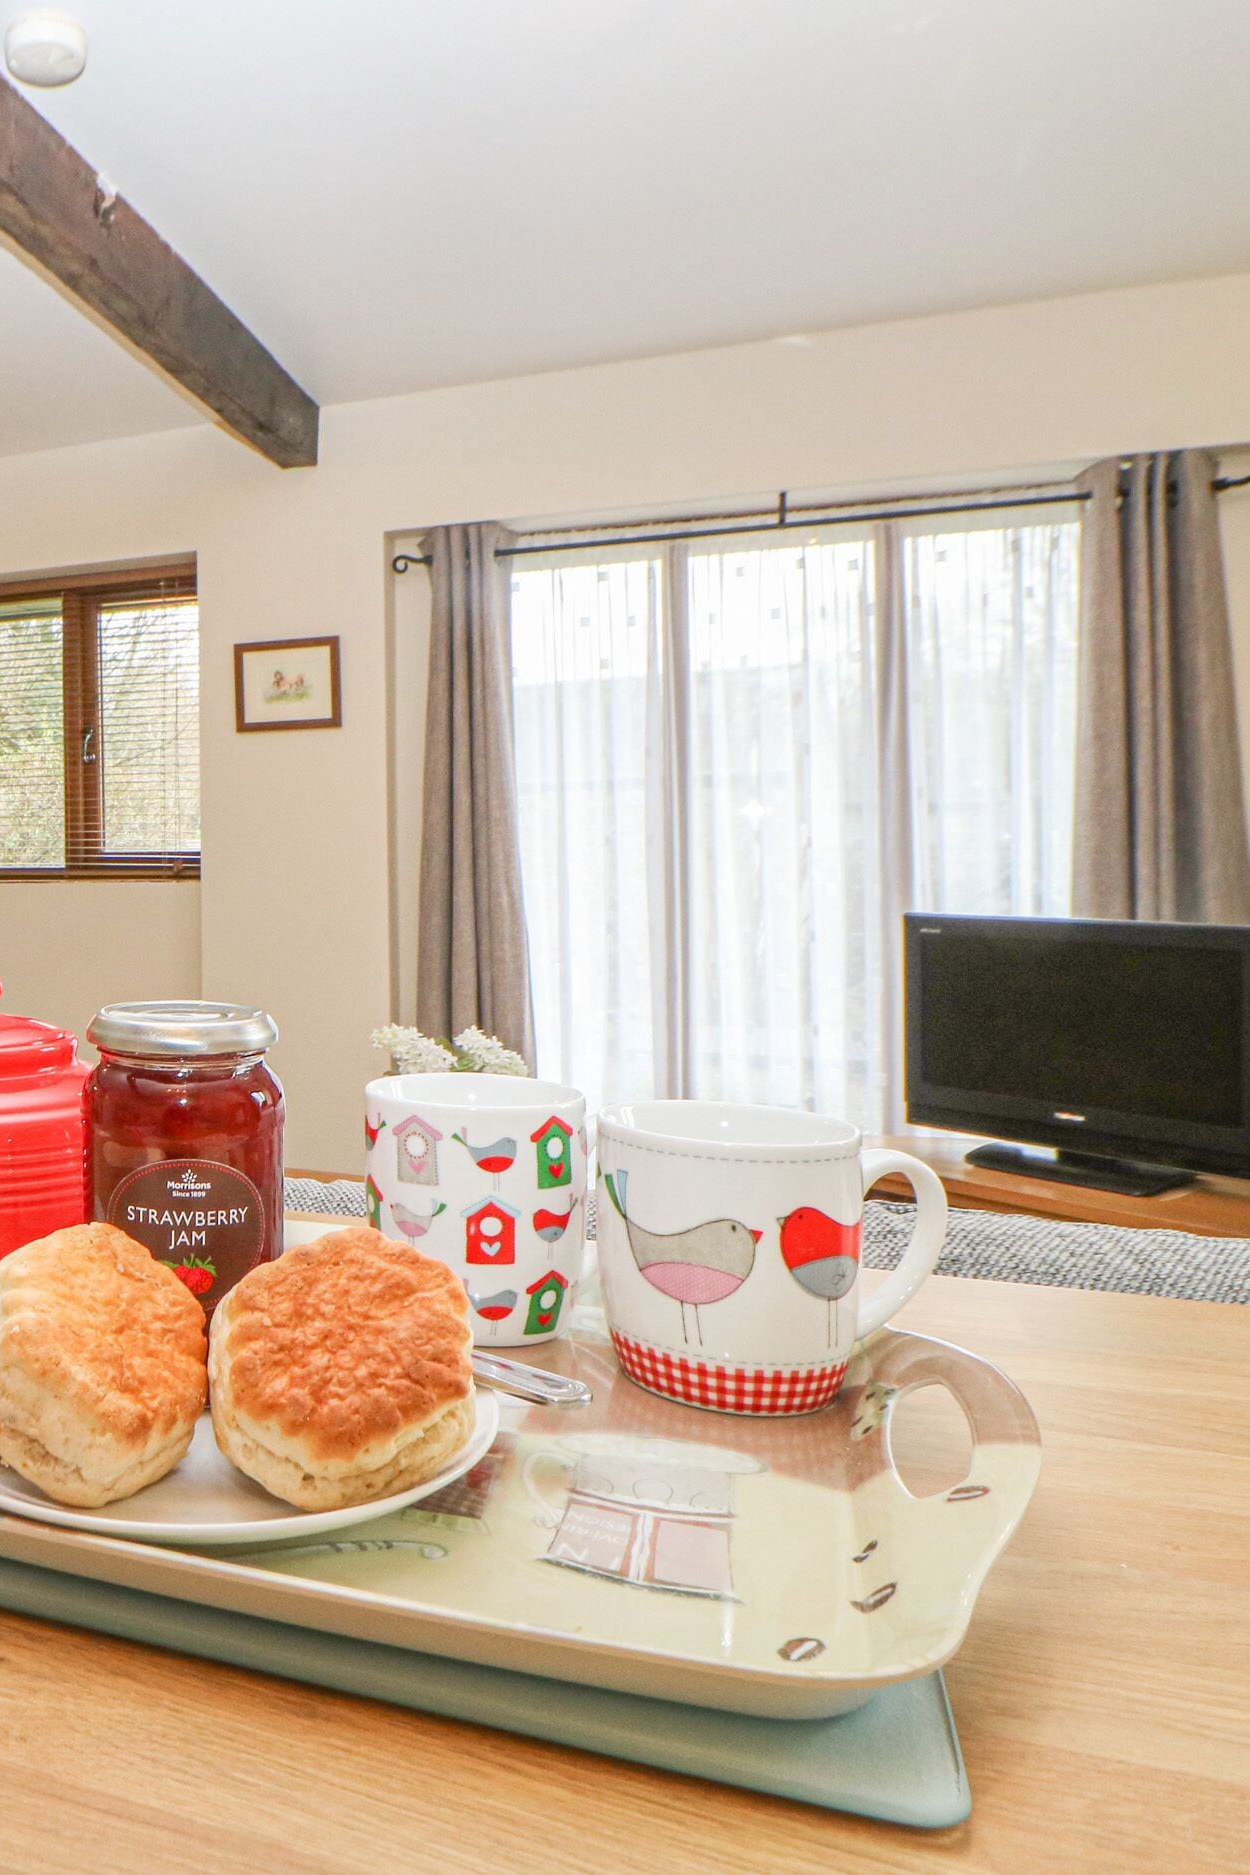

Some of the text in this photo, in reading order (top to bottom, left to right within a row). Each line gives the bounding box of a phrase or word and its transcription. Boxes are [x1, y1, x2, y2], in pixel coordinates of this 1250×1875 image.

[166, 1180, 212, 1190] Morrisons
[172, 1190, 206, 1198] Since 1899
[127, 1205, 248, 1227] STRAWBERRY
[168, 1230, 206, 1249] JAM
